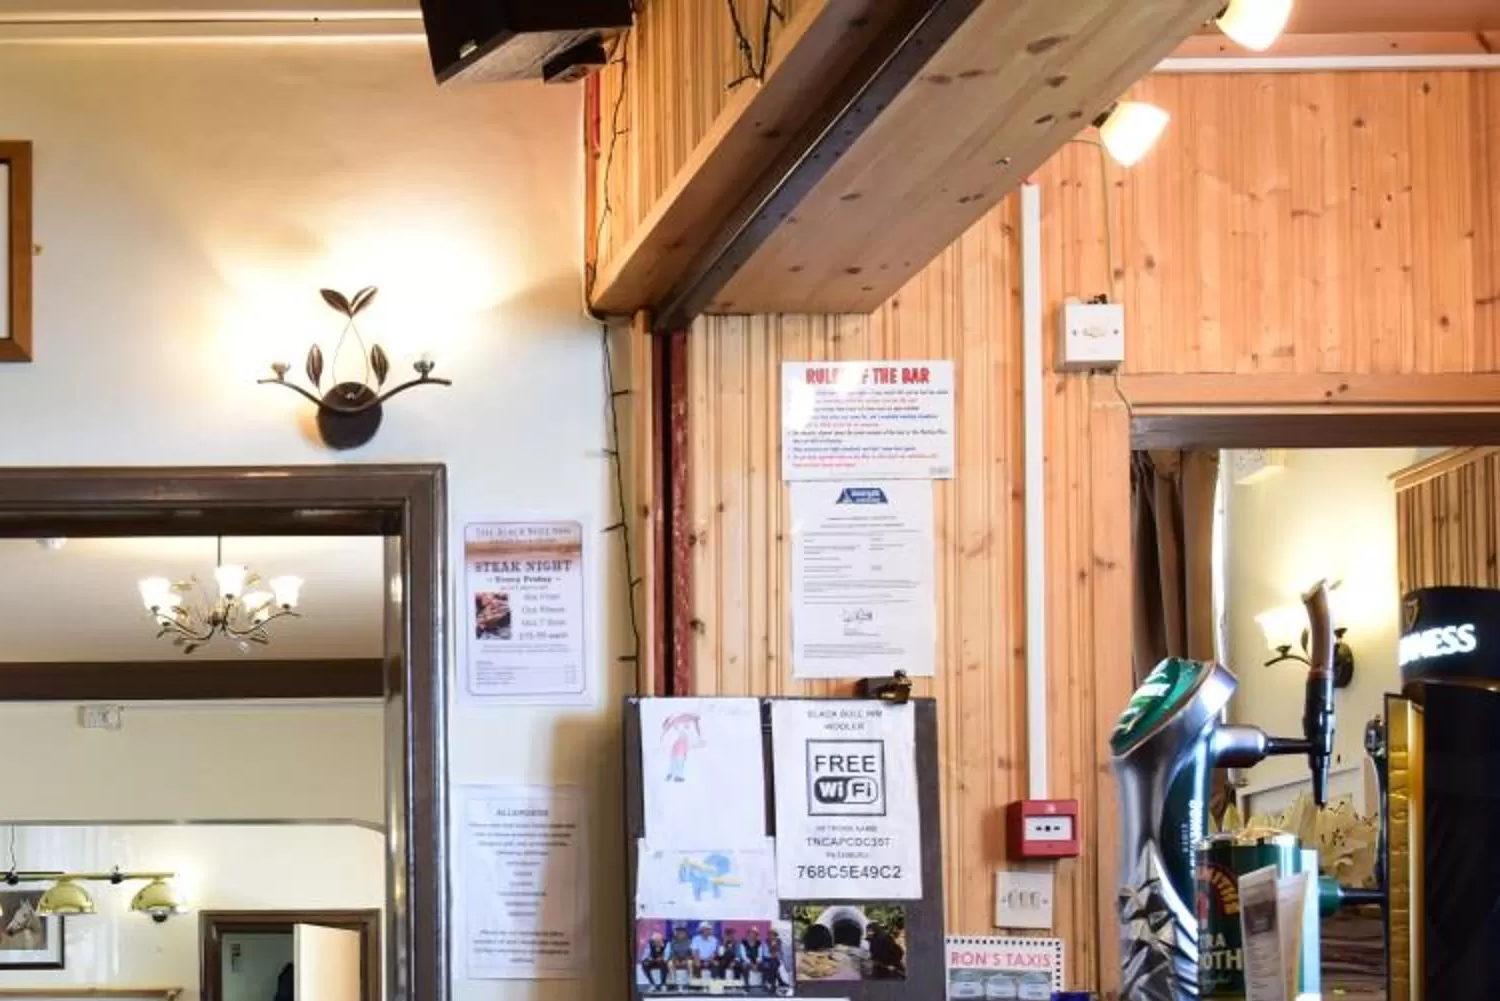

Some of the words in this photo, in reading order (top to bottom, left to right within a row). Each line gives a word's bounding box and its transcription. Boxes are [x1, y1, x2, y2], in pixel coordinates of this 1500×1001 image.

[872, 367, 898, 385] THE
[901, 366, 931, 385] BAR
[525, 559, 573, 573] NIGHT
[814, 754, 876, 773] FREE
[797, 865, 901, 879] 768C5E49C2
[1006, 952, 1051, 966] TAXIS
